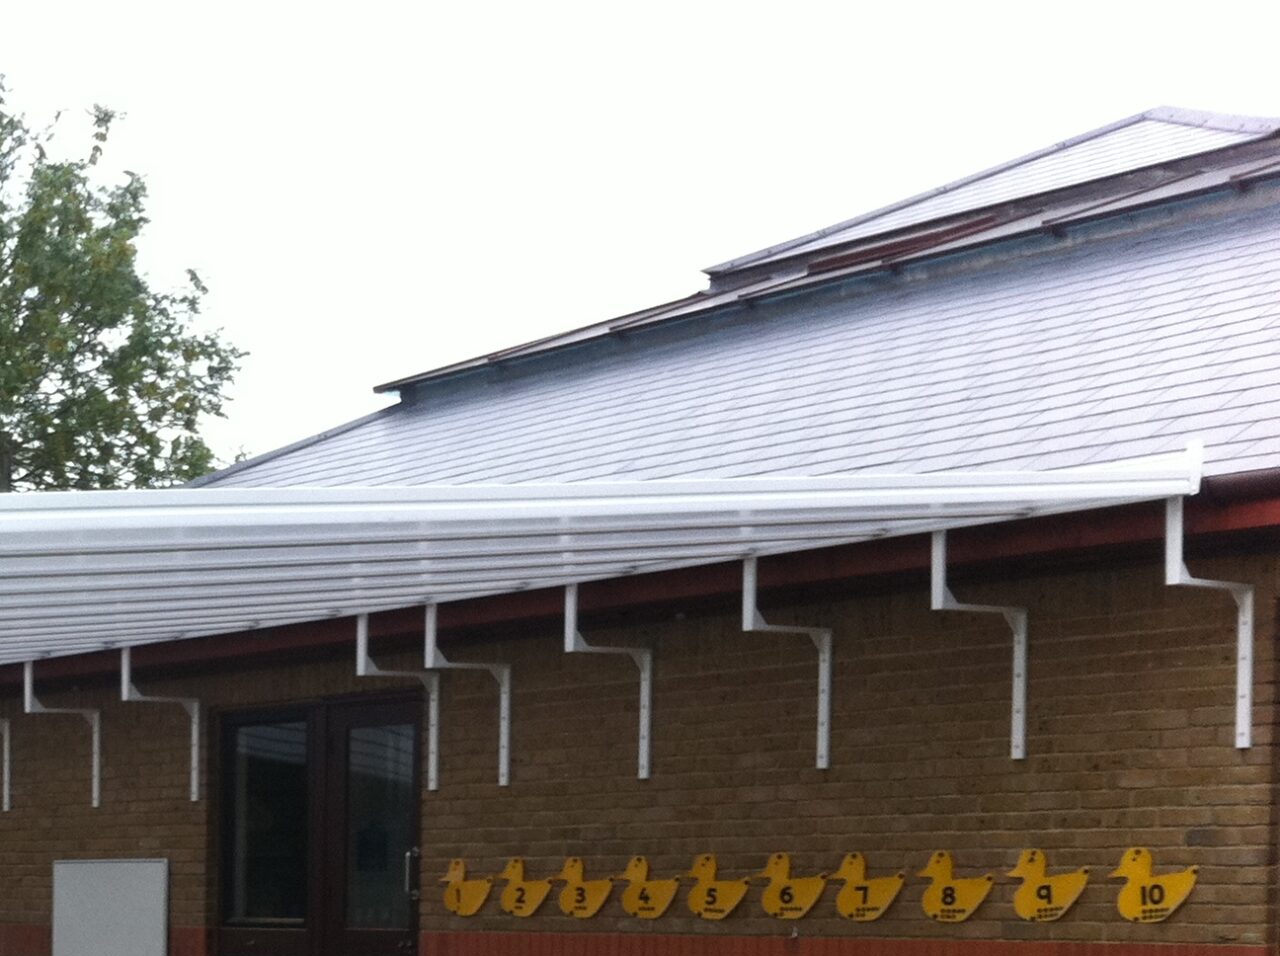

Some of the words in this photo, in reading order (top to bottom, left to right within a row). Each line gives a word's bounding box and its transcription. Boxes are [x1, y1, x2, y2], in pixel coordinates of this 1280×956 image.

[515, 887, 526, 904] 2
[575, 886, 586, 904] 3
[638, 887, 650, 904] 4
[705, 888, 718, 905] 5
[780, 886, 793, 904] 6
[854, 886, 869, 905] 7
[941, 886, 956, 906] 8
[1036, 885, 1052, 905] 9
[1141, 884, 1165, 906] 10
